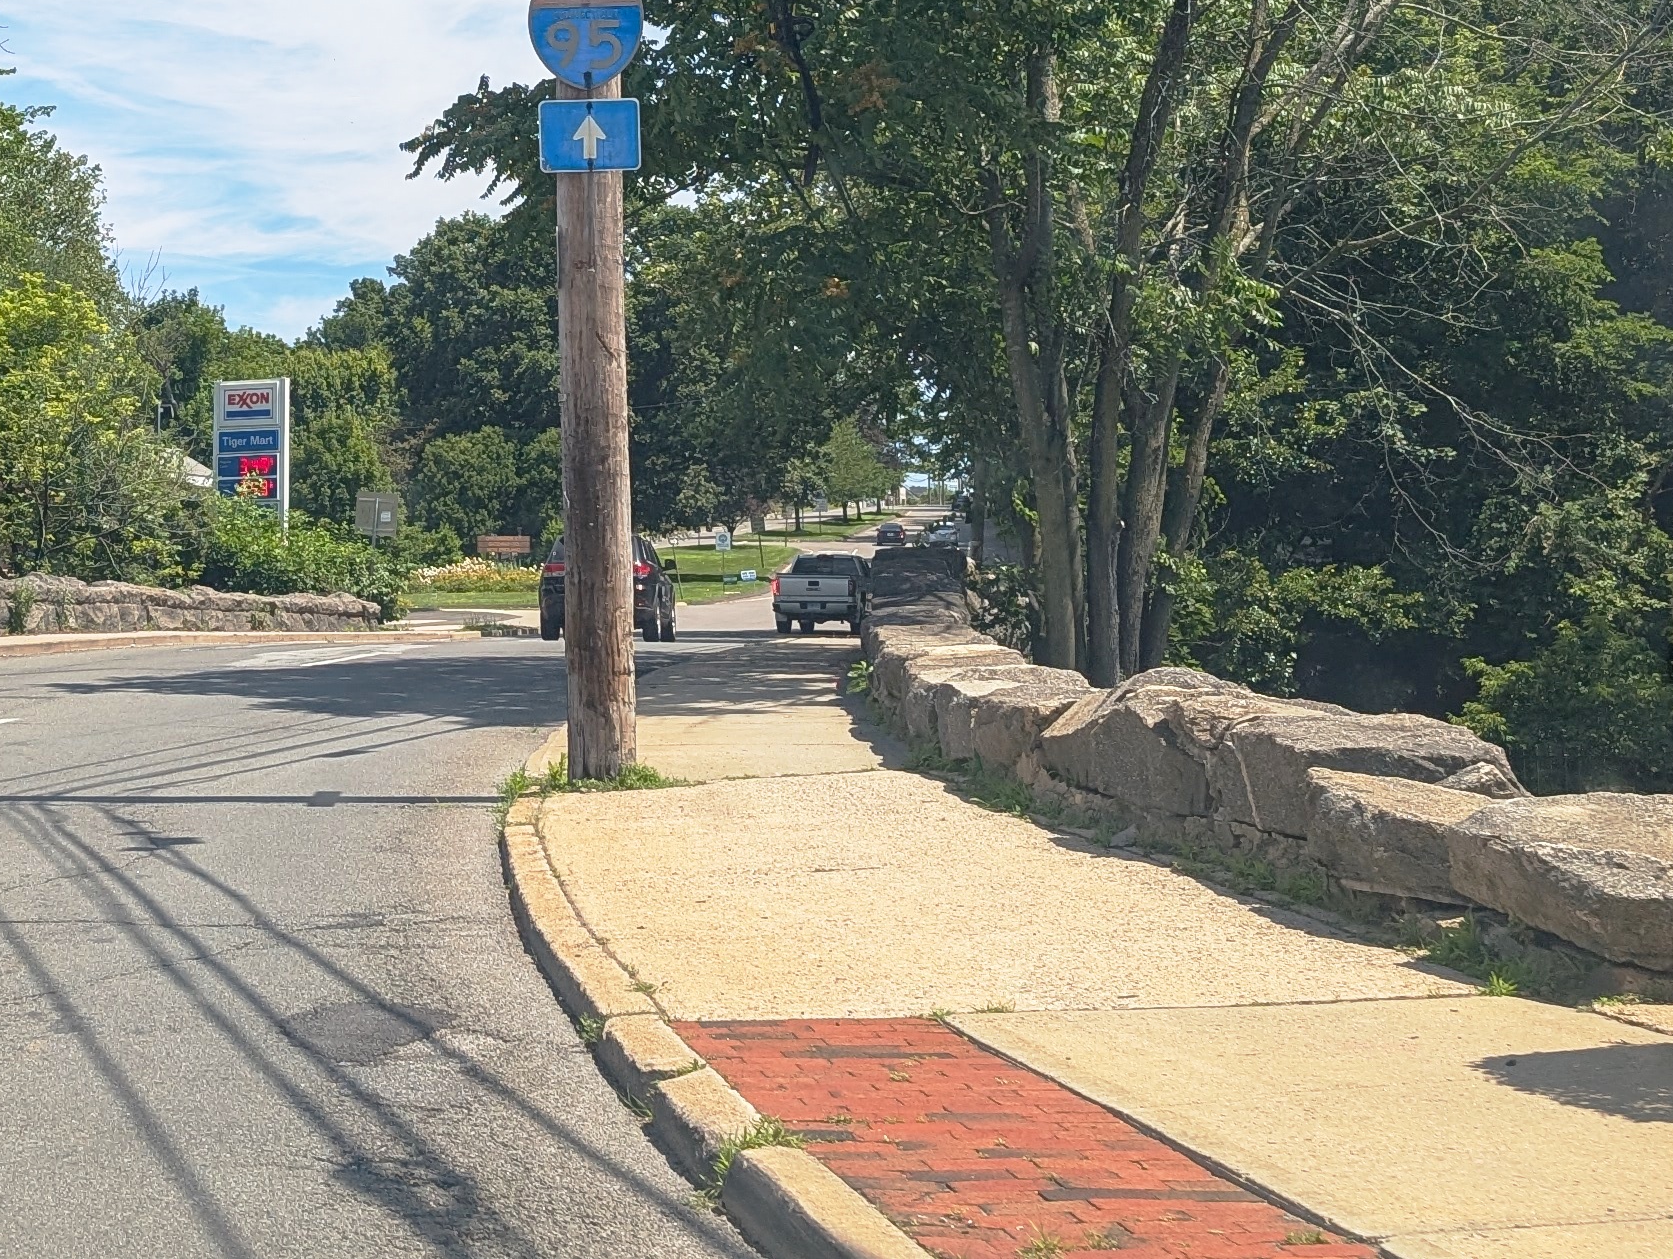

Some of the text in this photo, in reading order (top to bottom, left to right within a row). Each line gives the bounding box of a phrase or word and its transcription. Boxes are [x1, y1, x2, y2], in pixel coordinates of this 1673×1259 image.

[546, 20, 623, 69] 95
[227, 391, 270, 409] EXXON
[221, 435, 274, 449] Tiger Mart
